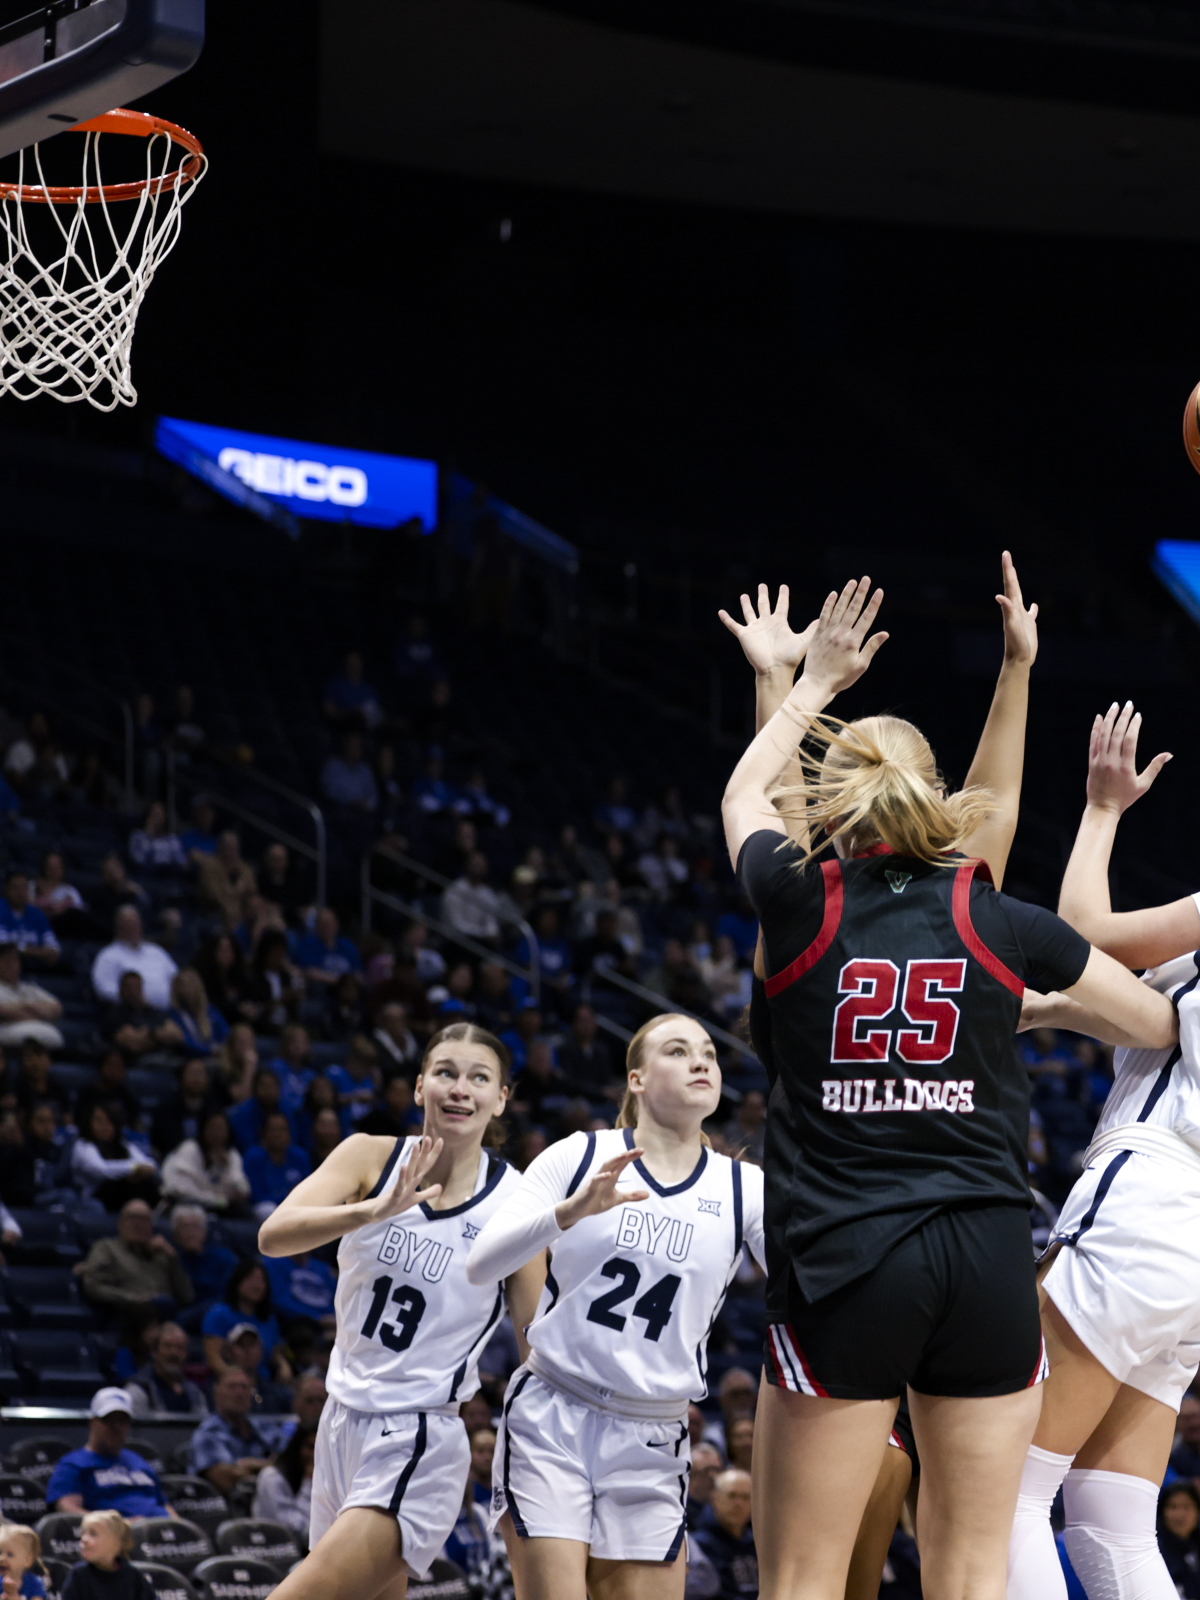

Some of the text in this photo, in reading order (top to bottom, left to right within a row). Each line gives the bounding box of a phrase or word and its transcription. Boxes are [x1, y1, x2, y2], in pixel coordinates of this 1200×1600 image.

[830, 957, 968, 1065] 25
[821, 1078, 975, 1113] BULLDOGS
[377, 1223, 454, 1284] BYU
[616, 1207, 694, 1263] BYU
[360, 1275, 427, 1353] 13
[586, 1257, 682, 1342] 24
